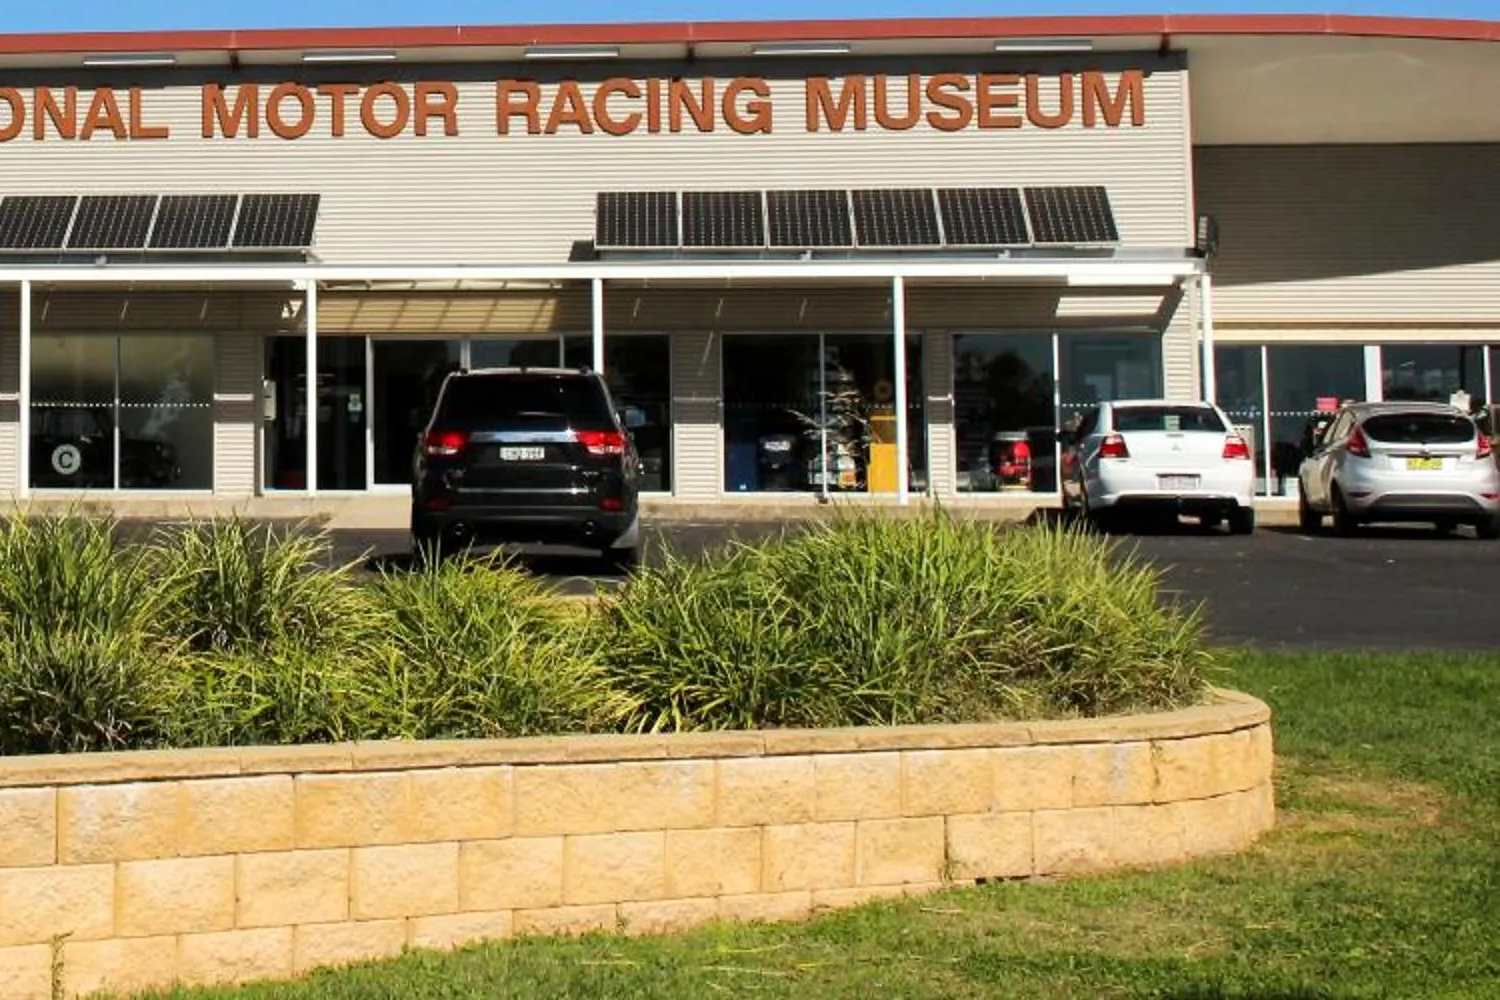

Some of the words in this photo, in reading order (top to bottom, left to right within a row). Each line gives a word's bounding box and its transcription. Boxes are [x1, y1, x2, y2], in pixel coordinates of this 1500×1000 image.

[201, 81, 459, 139] MOTOR
[496, 76, 772, 135] RACING
[805, 71, 1145, 132] MUSEUM
